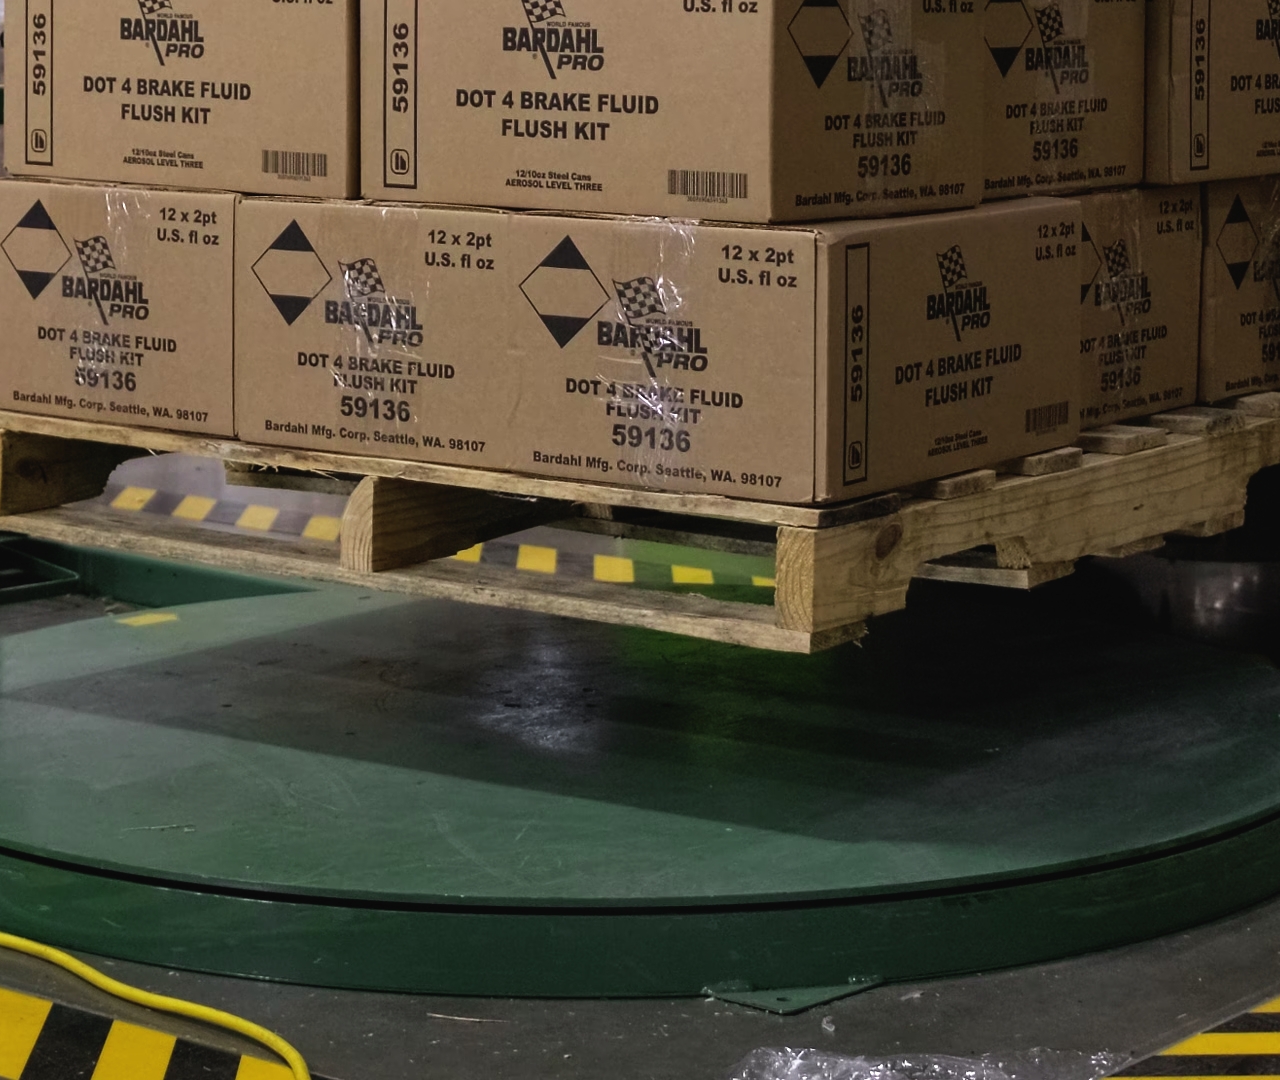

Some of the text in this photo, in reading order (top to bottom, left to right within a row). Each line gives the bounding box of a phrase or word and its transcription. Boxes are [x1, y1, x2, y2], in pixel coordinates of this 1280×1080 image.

[121, 19, 203, 41] BARDAHL
[502, 28, 603, 52] BARDAHL
[32, 16, 45, 96] 59136
[166, 43, 205, 57] PRO
[557, 54, 604, 70] PRO
[1025, 45, 1089, 70] BARDAHL
[1195, 19, 1205, 101] 59136
[1032, 138, 1079, 162] 59136
[857, 153, 911, 178] 59136
[505, 178, 603, 191] AEROSOL LEVEL THREE
[927, 287, 989, 319] BARDAHL
[961, 312, 990, 330] PRO
[298, 352, 454, 378] DOT 4 BRAKE FLUID
[851, 305, 862, 401] 59136
[13, 390, 209, 422] Bardahl Mfg. Corp. Seattle, WA. 98107
[340, 395, 410, 422] 59136
[612, 424, 691, 454] 59136
[533, 451, 782, 487] Bardahl Mfg. Corp. Seattle, WA. 98107
